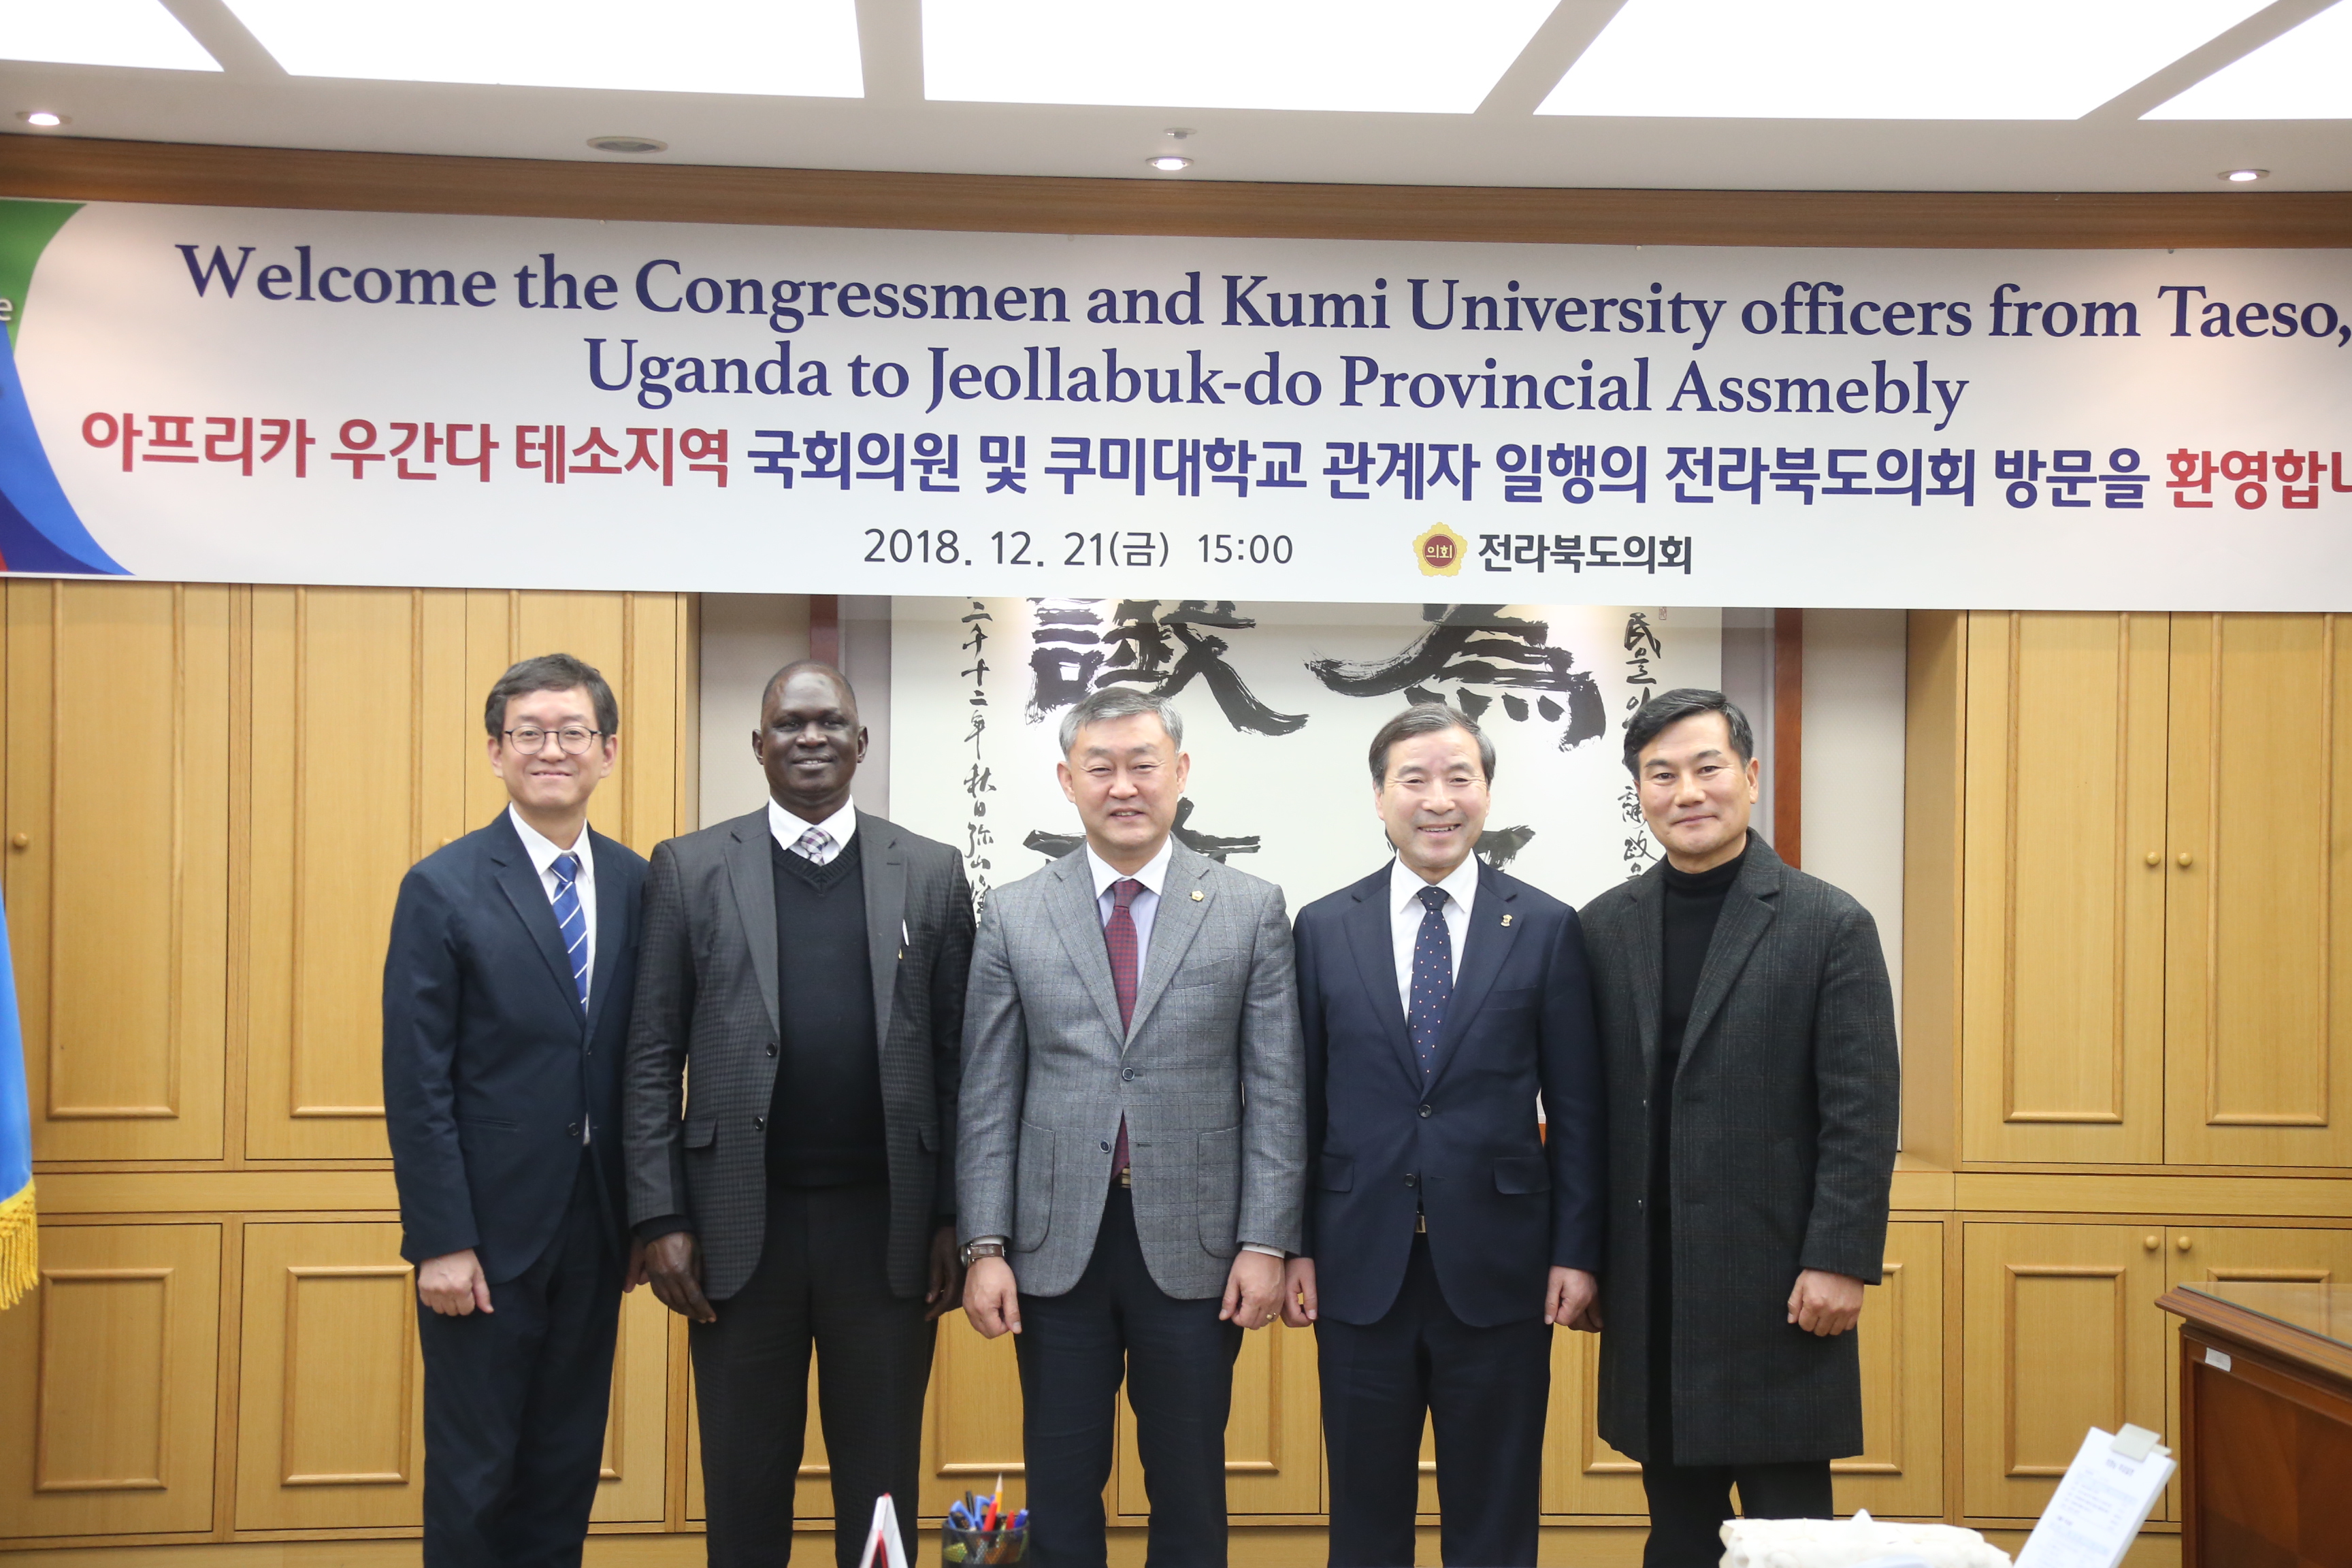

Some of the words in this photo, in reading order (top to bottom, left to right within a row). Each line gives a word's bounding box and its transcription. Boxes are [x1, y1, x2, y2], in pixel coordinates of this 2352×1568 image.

[176, 245, 495, 306] Welcome
[514, 253, 617, 310] the
[636, 259, 1070, 333] Congressmen
[1088, 272, 1204, 325] and
[1222, 276, 1390, 328] Kumi
[1407, 279, 1727, 350] University
[1742, 282, 1972, 336] officers
[1989, 283, 2140, 337] from
[2158, 286, 2351, 347] Taeso,
[584, 338, 832, 409] Uganda
[847, 355, 909, 397] to
[926, 346, 1322, 414] Jeollabuk-do
[1340, 356, 1652, 410] Provincial
[1666, 360, 1970, 431] Assmebly
[82, 412, 316, 478] 아프리카
[331, 419, 499, 482] 우간다
[516, 425, 728, 487] 테소지역
[748, 430, 960, 492] 국회의원
[980, 436, 1026, 494] 및
[1045, 437, 1307, 497] 쿠미대학교
[1323, 442, 1480, 501] 관계자
[1497, 443, 1646, 504] 일행의
[1666, 447, 1974, 506] 전라북도의회
[1995, 448, 2150, 508] 방문을
[864, 529, 971, 566] 2018.
[992, 532, 1043, 567] 12.
[1064, 532, 1169, 567] 21(금)
[1198, 534, 1292, 564] 15:00
[1426, 544, 1453, 559] 의회
[1478, 534, 1691, 574] 전라북도의회
